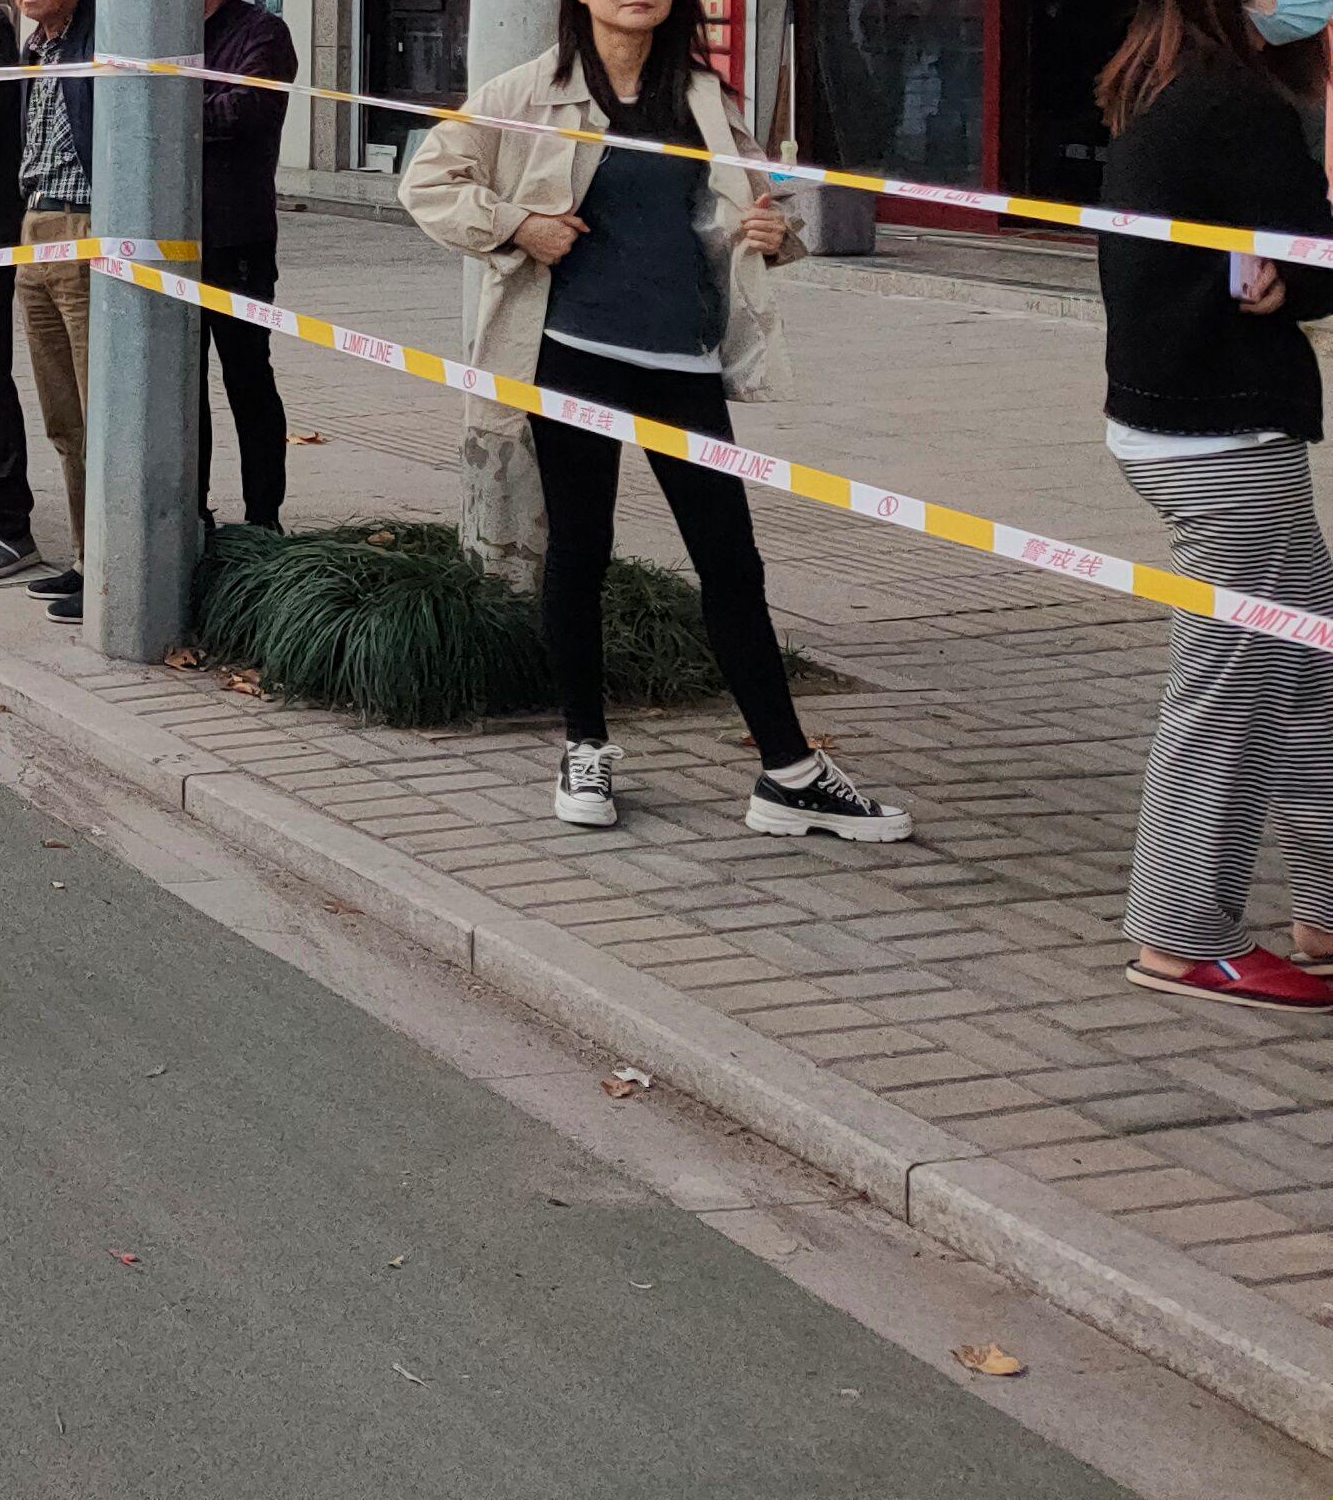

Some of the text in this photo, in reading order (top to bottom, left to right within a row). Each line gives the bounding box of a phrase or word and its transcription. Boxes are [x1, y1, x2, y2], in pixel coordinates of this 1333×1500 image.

[342, 332, 394, 364] LIMIT LINE
[561, 399, 614, 431] 警戒线
[699, 441, 777, 481] LIMIT LINE
[1021, 537, 1104, 578] 警戒线
[1231, 600, 1299, 635] LIMIT
